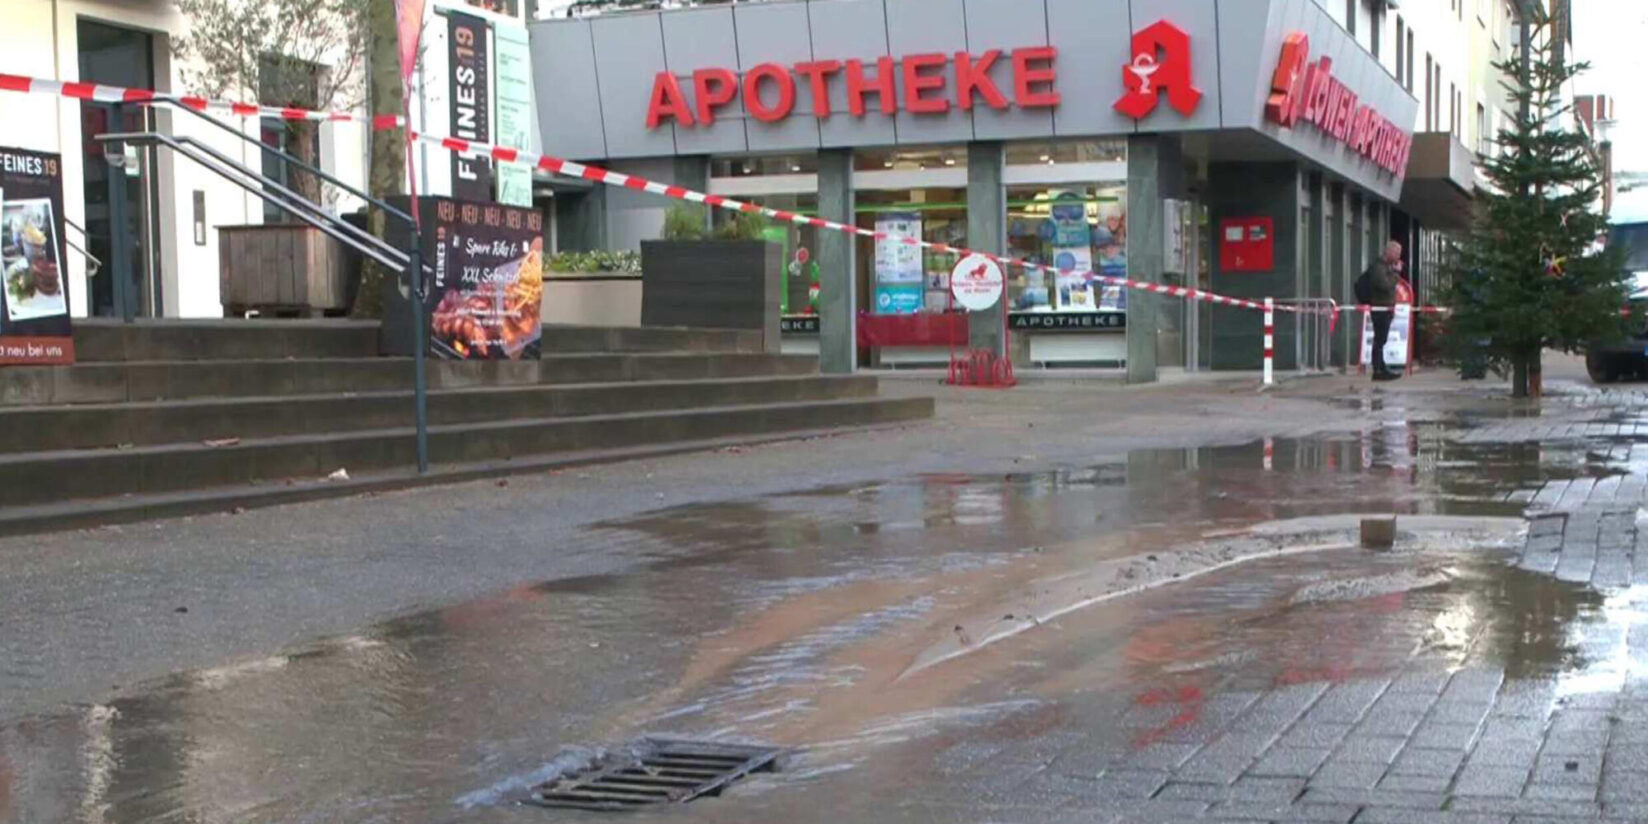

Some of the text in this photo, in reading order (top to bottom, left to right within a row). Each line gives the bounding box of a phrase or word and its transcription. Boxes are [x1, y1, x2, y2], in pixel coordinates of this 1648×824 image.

[455, 26, 475, 61] 19
[646, 46, 1061, 129] APOTHEKE
[43, 158, 57, 177] 19
[438, 202, 542, 231] NEU NEU NEU NEU NEU
[436, 242, 446, 287] FEINES
[461, 266, 480, 283] XXL
[1016, 316, 1120, 326] APOTHEKE
[28, 342, 43, 357] bei
